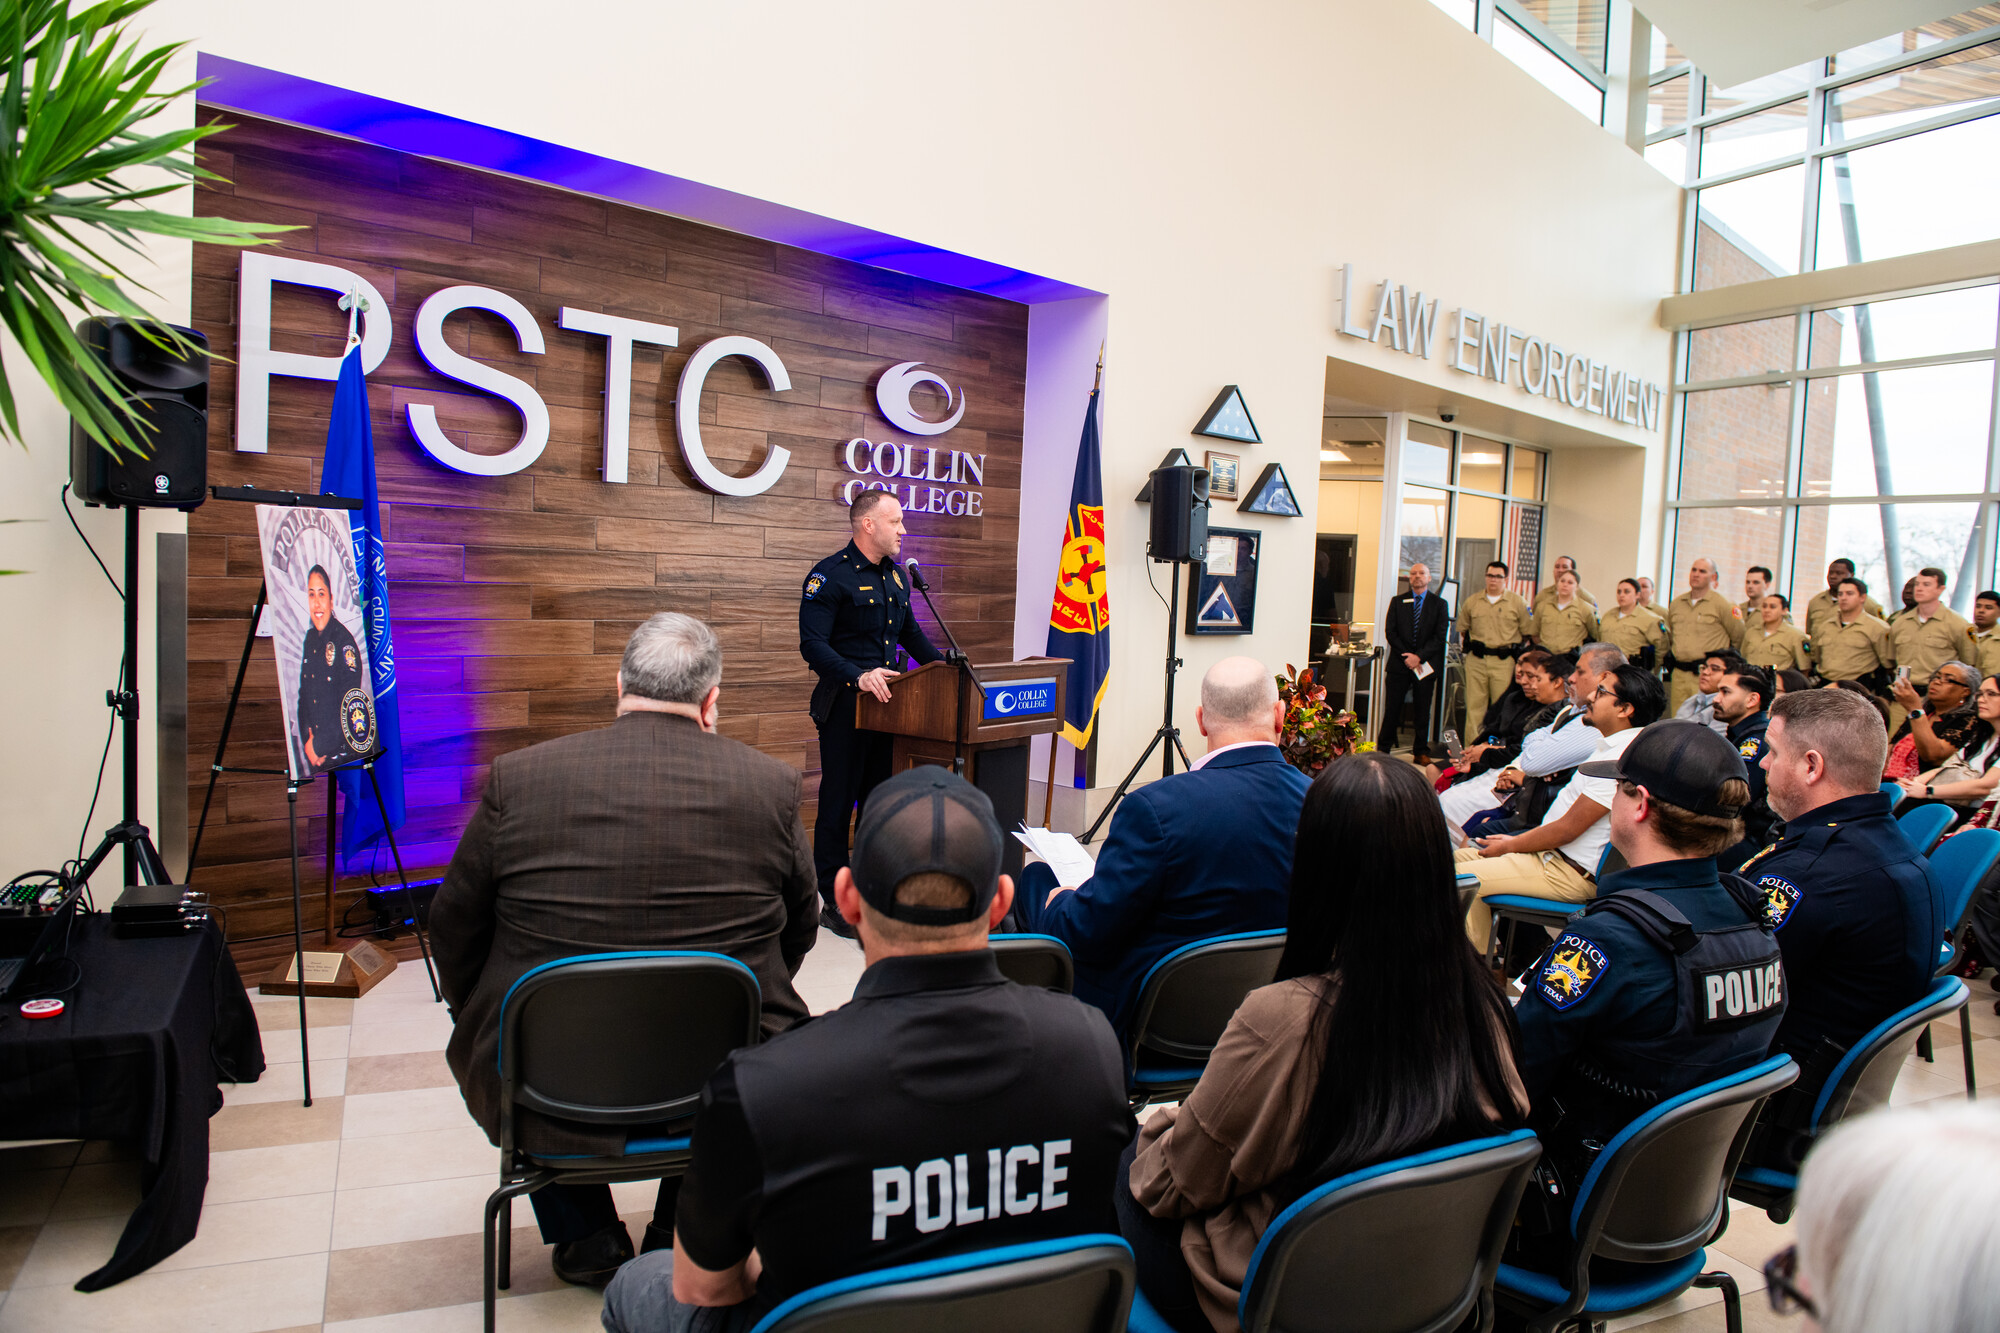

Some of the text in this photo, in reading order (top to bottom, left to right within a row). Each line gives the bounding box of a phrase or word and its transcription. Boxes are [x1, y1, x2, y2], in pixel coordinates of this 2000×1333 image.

[1341, 263, 1666, 433] LAW ENFORCEMENT
[235, 250, 792, 497] PSTC
[845, 437, 987, 487] COLLIN
[275, 508, 360, 599] POLICE OFFICER
[371, 596, 385, 653] COUNT
[1053, 599, 1087, 626] IRE
[1017, 699, 1047, 710] COLLEGE
[1018, 688, 1048, 701] COLLIN
[1758, 877, 1801, 901] POLICE
[1561, 935, 1606, 969] POLICE
[1543, 984, 1564, 1002] TEXAS
[1705, 960, 1782, 1020] POLICE
[872, 1138, 1072, 1241] POLICE
